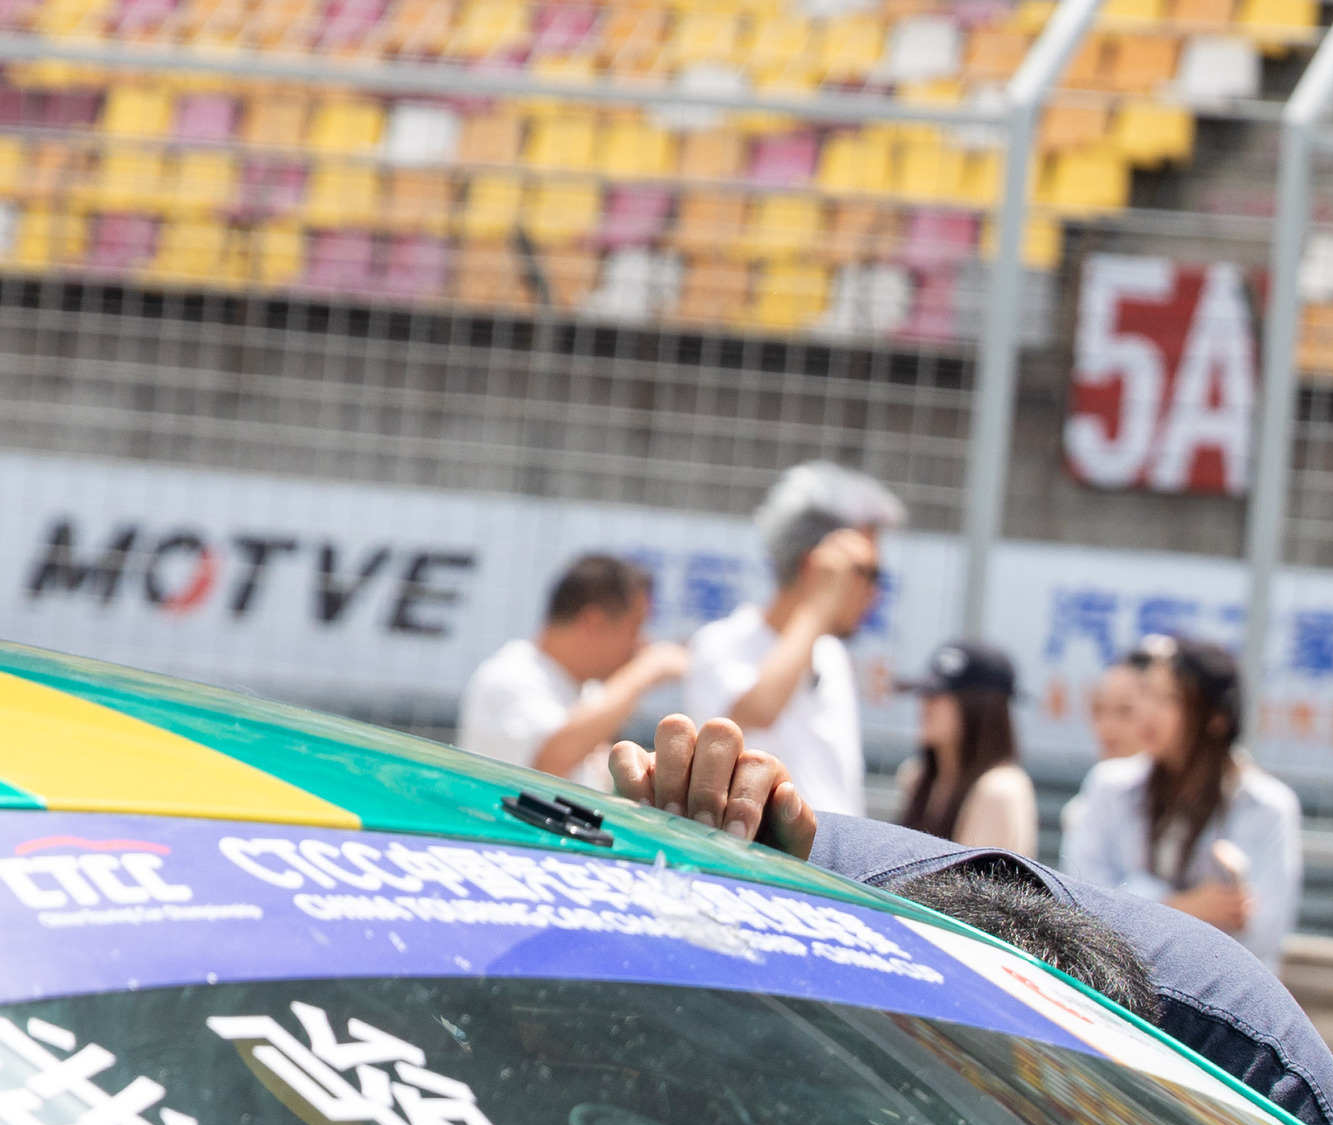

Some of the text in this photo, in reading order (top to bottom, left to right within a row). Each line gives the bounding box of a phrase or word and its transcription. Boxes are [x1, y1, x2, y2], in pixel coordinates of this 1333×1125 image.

[1064, 253, 1258, 492] 5A
[28, 515, 477, 636] MOTVE
[0, 852, 194, 909] CTCC
